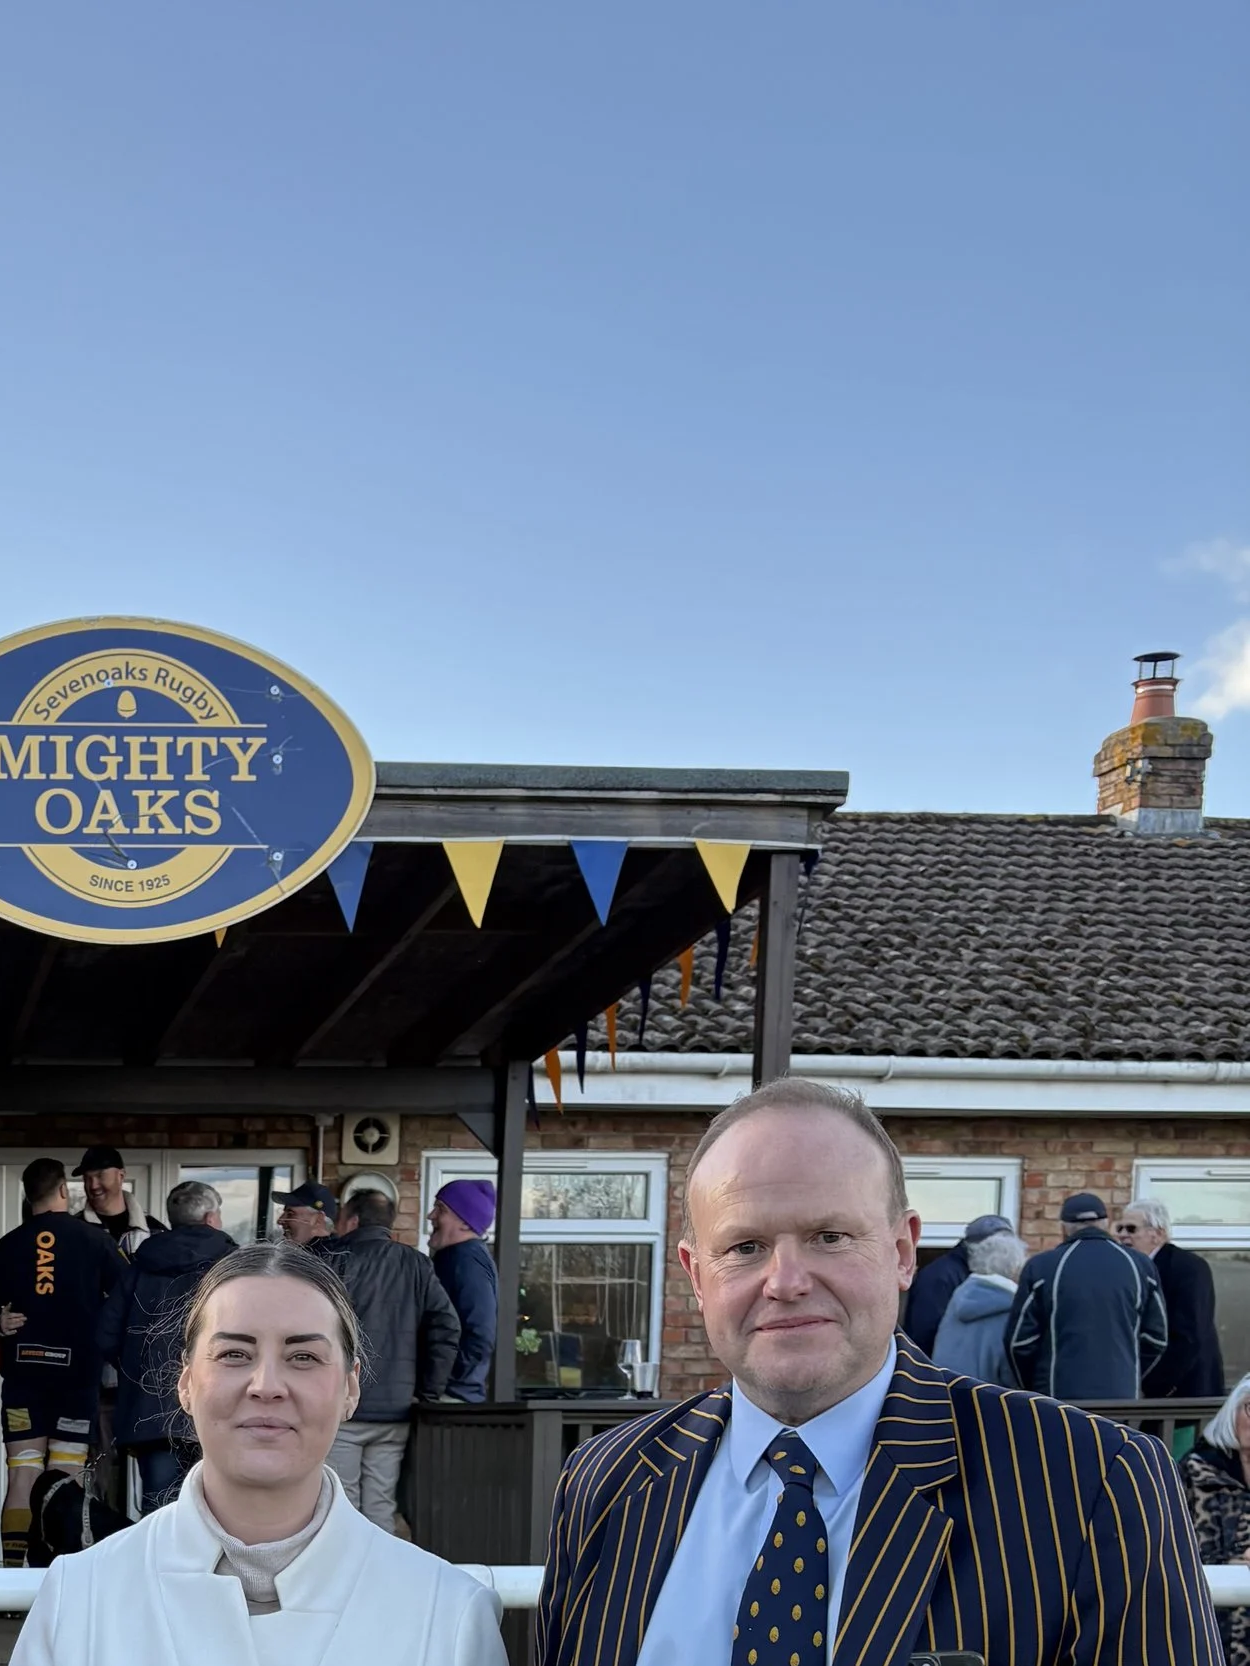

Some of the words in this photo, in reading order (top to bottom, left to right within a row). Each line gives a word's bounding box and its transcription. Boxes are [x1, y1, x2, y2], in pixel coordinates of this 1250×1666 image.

[33, 661, 148, 722] Sevenoaks
[154, 667, 220, 723] Rugby
[34, 788, 222, 836] OAKS
[88, 873, 135, 893] SINCE
[137, 874, 172, 893] 1925
[35, 1230, 56, 1296] OAKS
